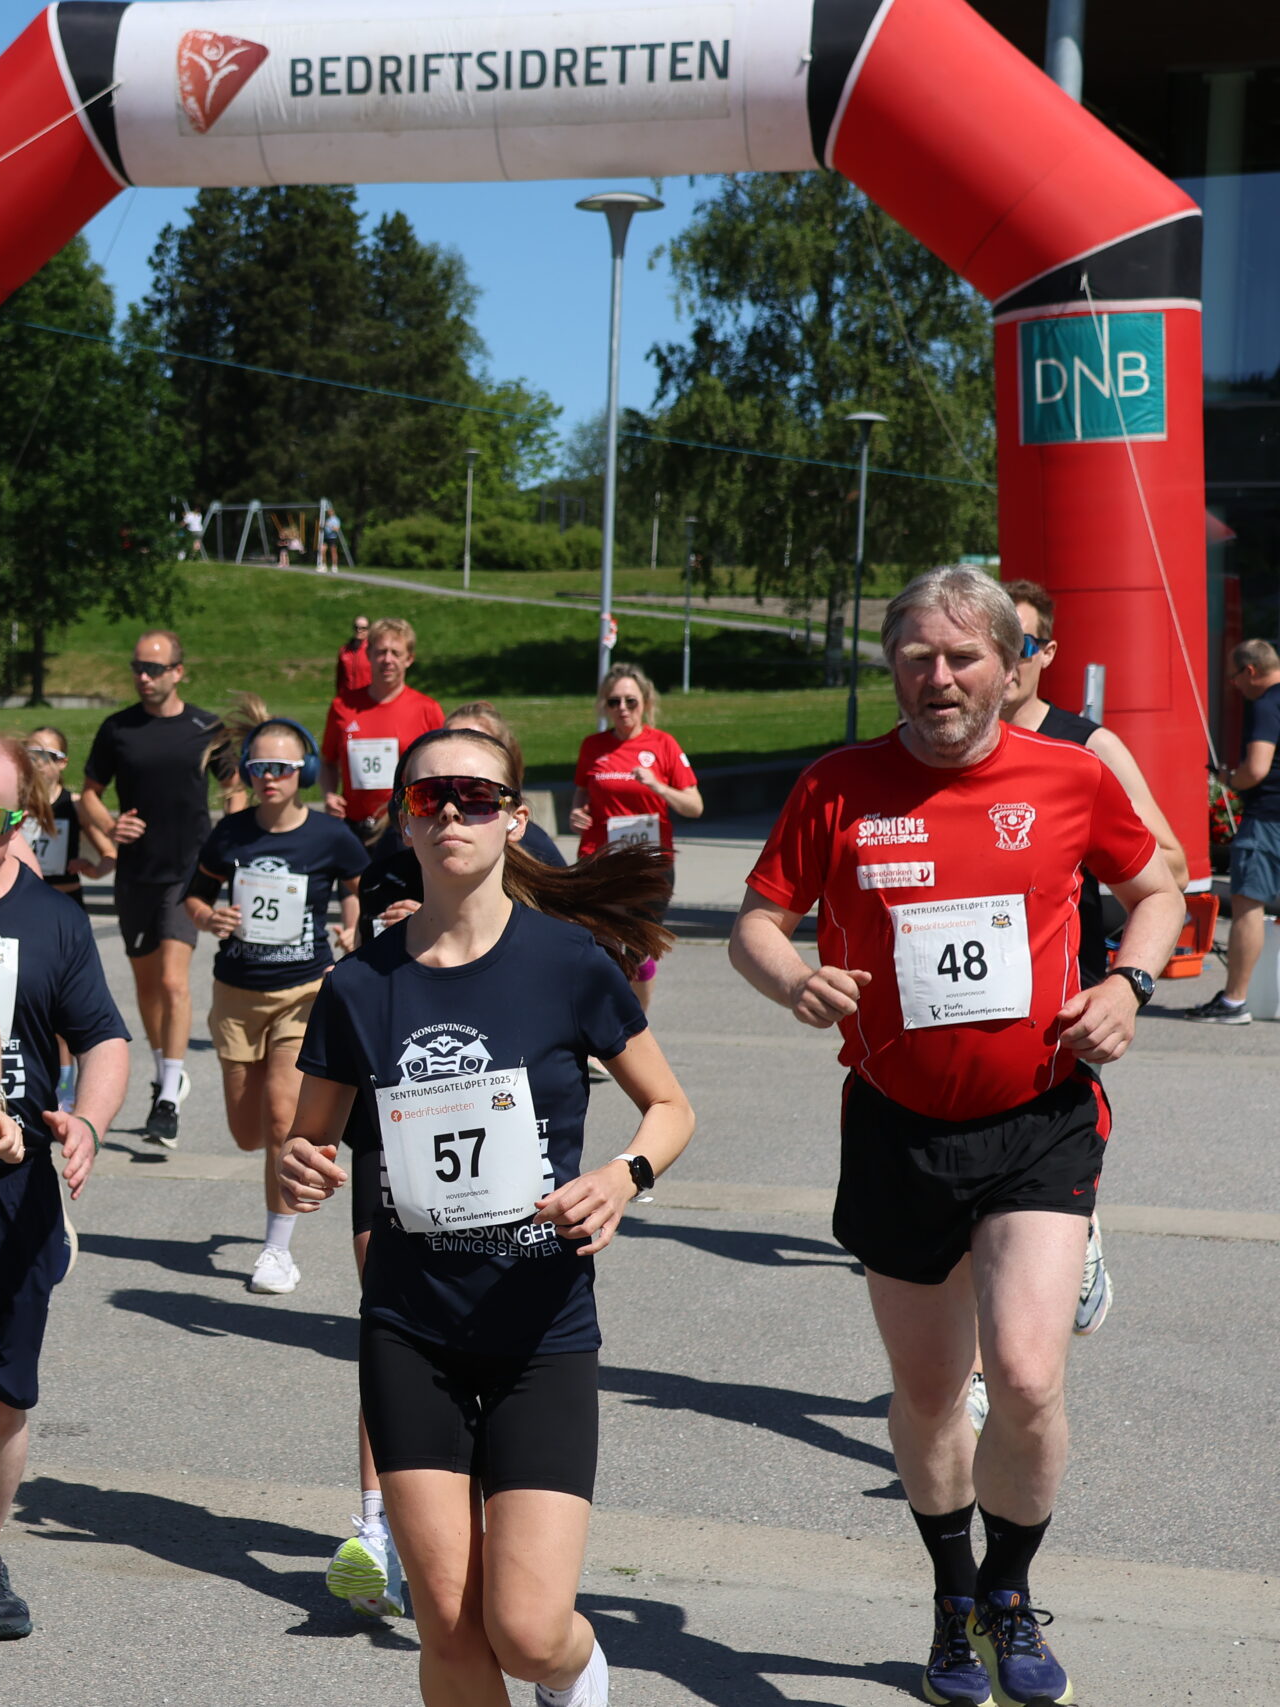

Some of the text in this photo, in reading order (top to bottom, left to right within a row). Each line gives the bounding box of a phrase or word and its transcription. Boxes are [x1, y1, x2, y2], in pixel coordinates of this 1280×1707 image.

[290, 39, 730, 97] BEDRIFTSIDRETTEN
[363, 757, 381, 774] 36
[858, 816, 916, 837] SPORTEN
[868, 833, 929, 846] INTERSPORT
[251, 896, 279, 921] 25
[902, 900, 1010, 916] SENTRUMSGATELØPET 2025
[937, 940, 988, 982] 48
[944, 1006, 1015, 1018] Konsulenttjenester
[411, 1023, 479, 1041] KONGSVINGER
[390, 1075, 511, 1101] SENTRUMSGATELØPET 2025
[404, 1101, 475, 1120] Bedriftsidretten
[433, 1127, 487, 1183] 57
[445, 1207, 524, 1224] Konsulenttjenester
[425, 1237, 562, 1258] ENINGSSENTER
